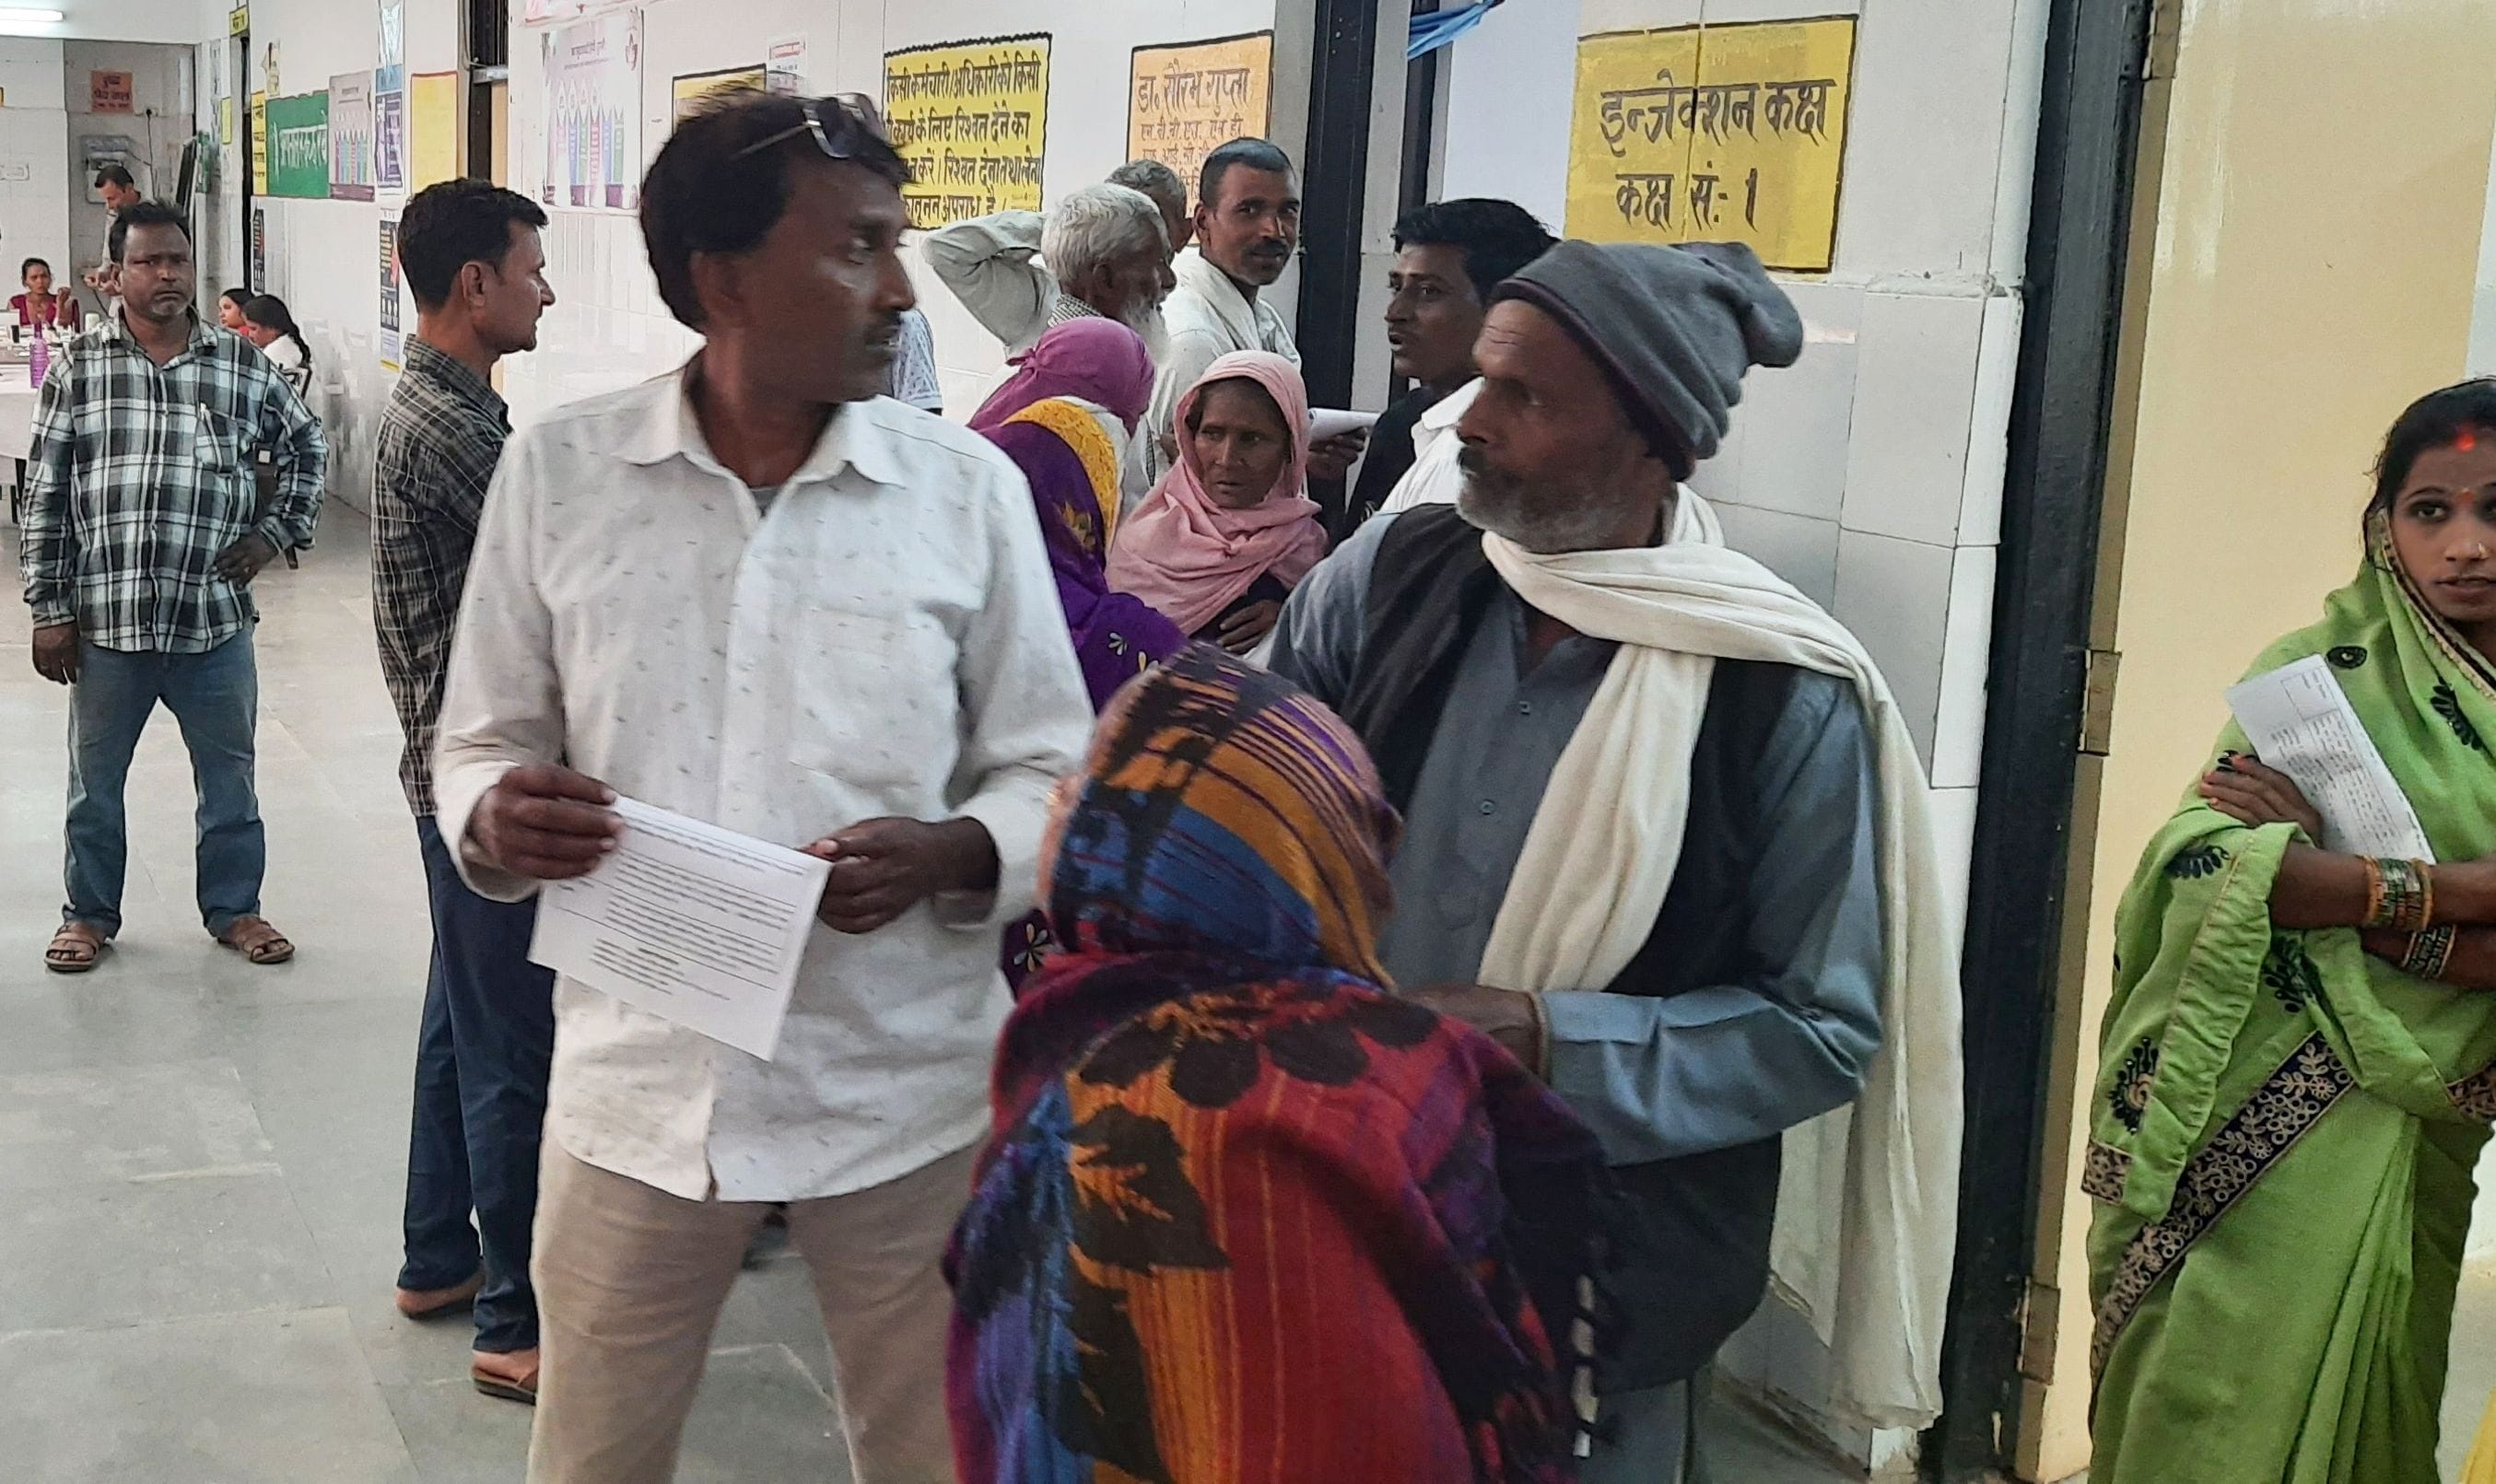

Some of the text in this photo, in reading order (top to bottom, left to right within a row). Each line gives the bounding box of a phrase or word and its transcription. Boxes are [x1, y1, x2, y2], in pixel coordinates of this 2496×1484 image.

[886, 66, 911, 103] किसी
[1014, 50, 1042, 94] किसी
[1205, 67, 1250, 116] गुप्ता
[894, 109, 916, 146] कार्य
[915, 106, 927, 144] के
[928, 106, 954, 143] लिए
[955, 105, 990, 144] रिश्वत
[990, 99, 1012, 146] देने
[1012, 111, 1031, 142] का
[1600, 68, 1837, 158] इन्जेक्शन कक्ष
[919, 147, 935, 185] करें
[943, 146, 978, 185] रिश्वत
[978, 146, 1001, 188] देना
[941, 193, 982, 223] अपराध
[1614, 173, 1675, 232] कक्ष
